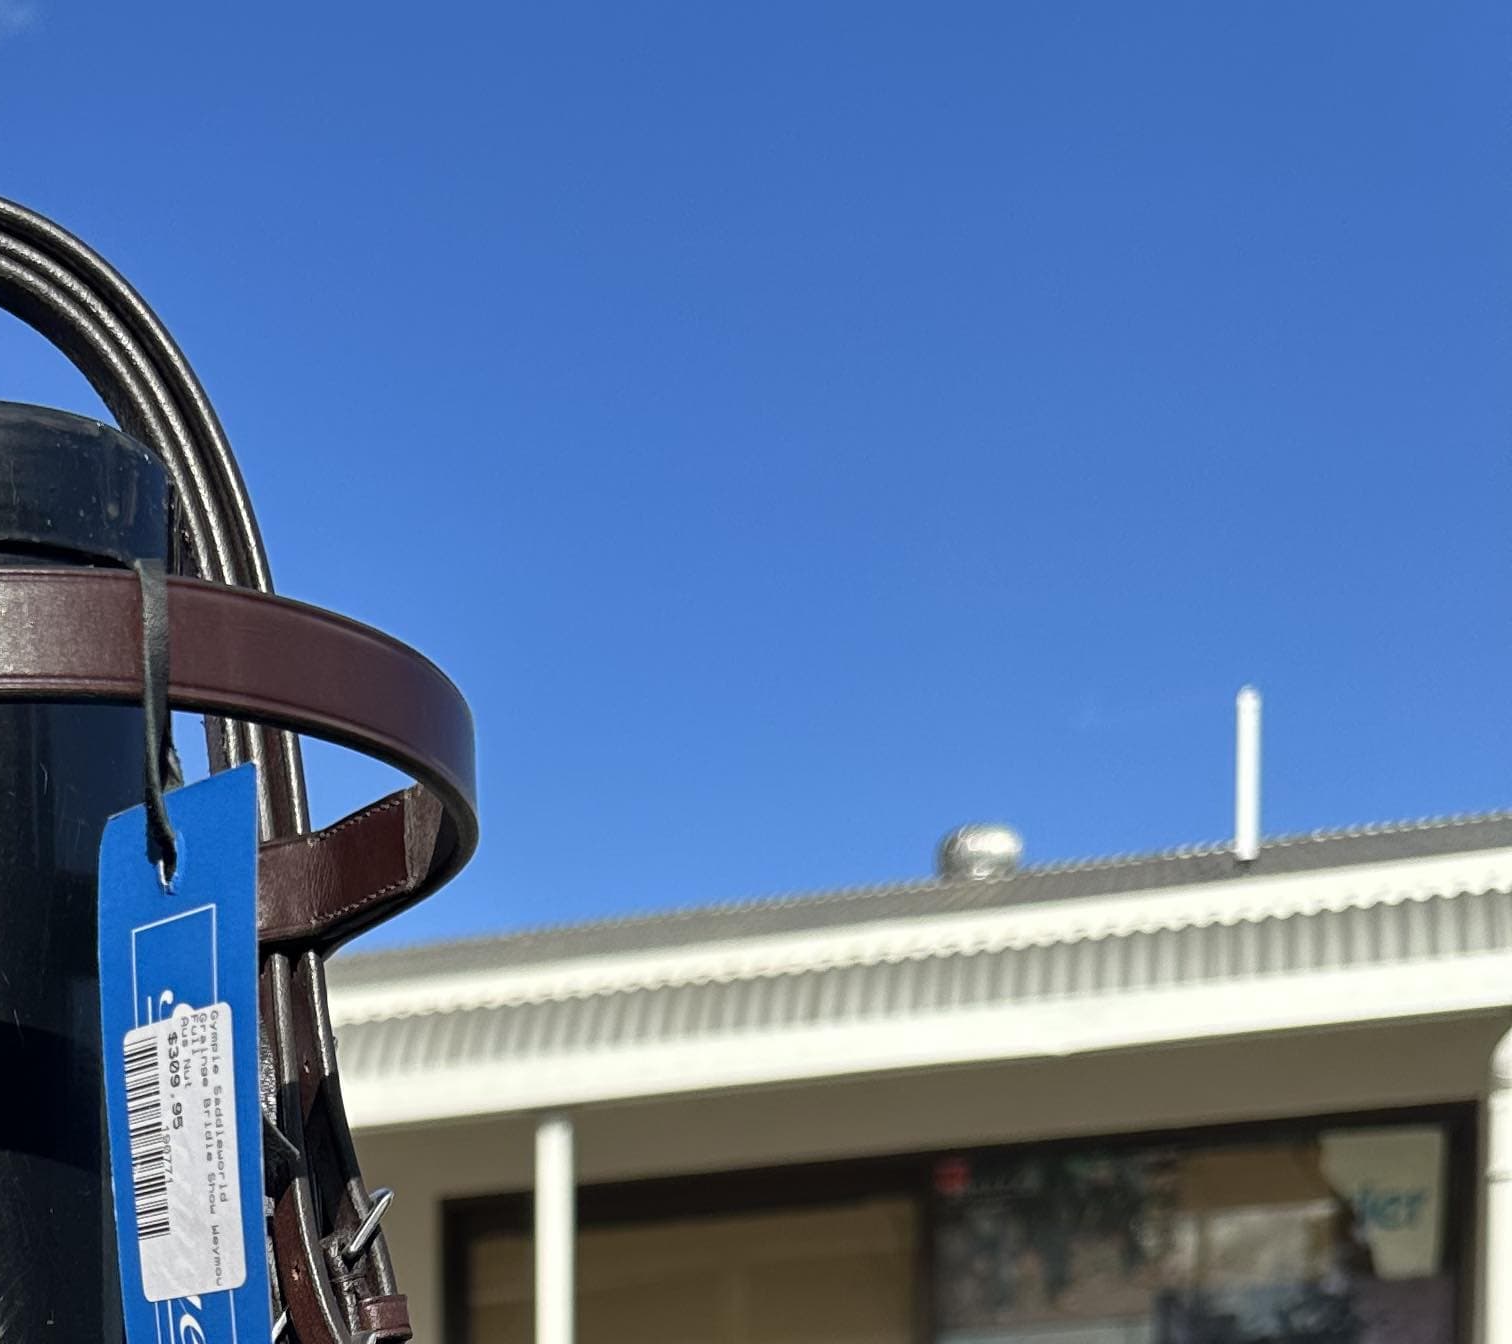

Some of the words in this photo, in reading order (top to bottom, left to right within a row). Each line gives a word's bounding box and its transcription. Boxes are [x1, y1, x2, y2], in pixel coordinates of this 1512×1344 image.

[180, 1017, 190, 1047] Aus
[190, 1014, 200, 1055] Full
[199, 1013, 209, 1087] Grainge
[209, 1010, 220, 1074] Gympie
[167, 1032, 184, 1130] $309.95
[182, 1058, 193, 1088] Nut
[203, 1098, 213, 1161] Bridle
[213, 1085, 228, 1202] Saddleworld
[207, 1173, 217, 1214] Show
[211, 1225, 225, 1286] Weymou
